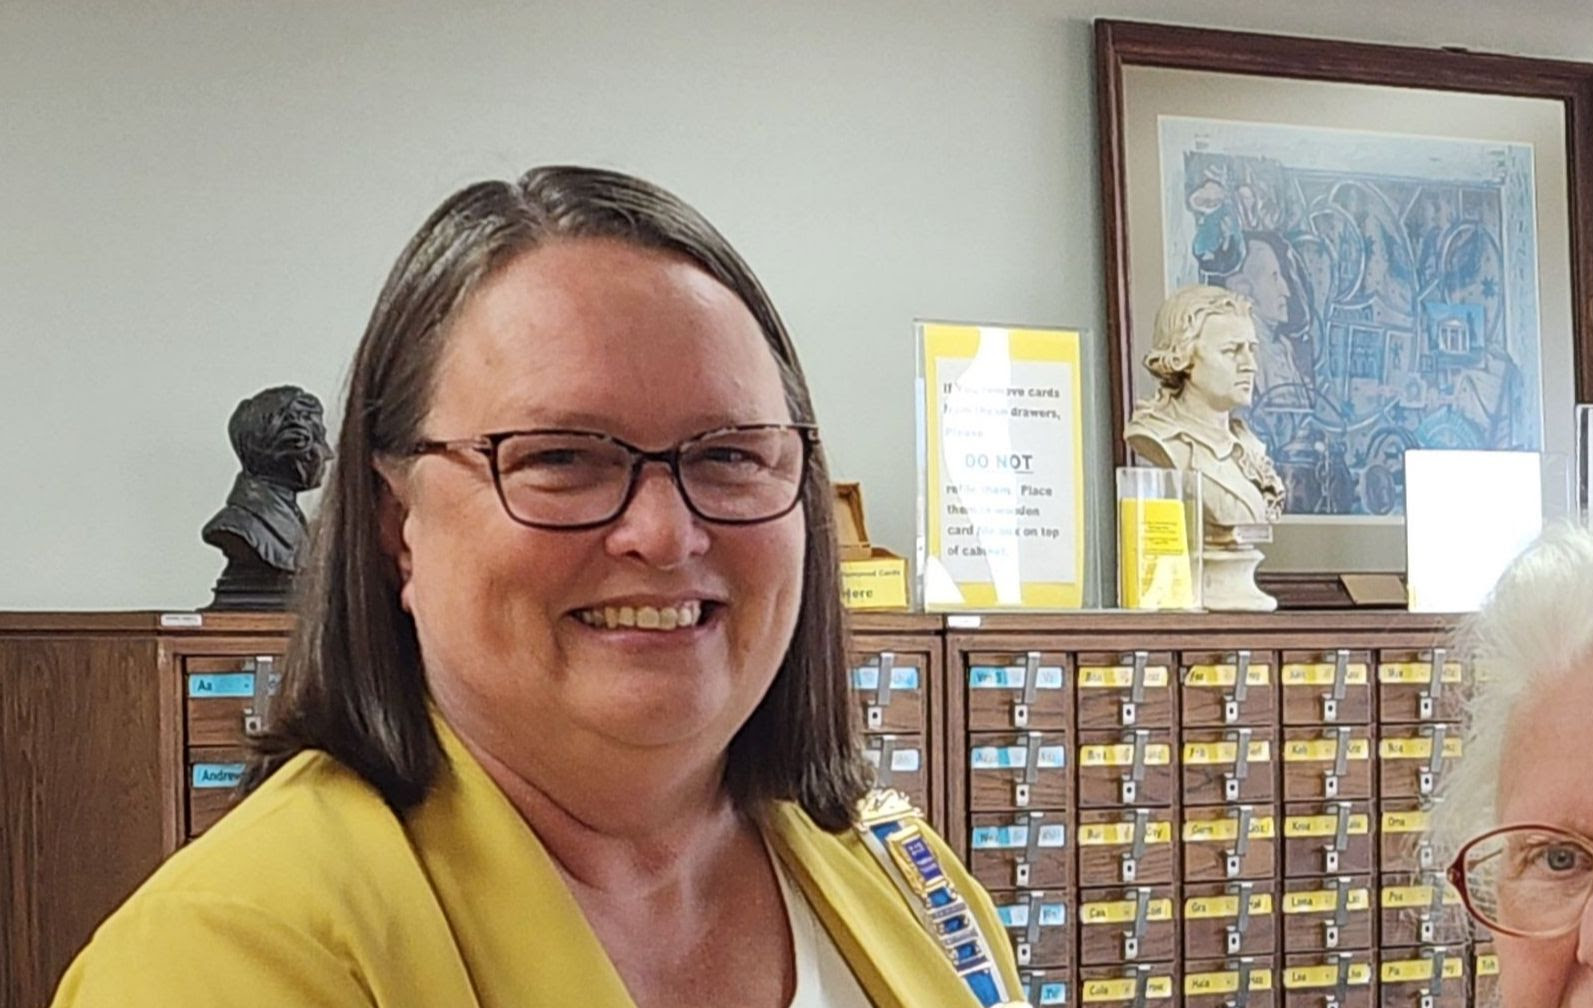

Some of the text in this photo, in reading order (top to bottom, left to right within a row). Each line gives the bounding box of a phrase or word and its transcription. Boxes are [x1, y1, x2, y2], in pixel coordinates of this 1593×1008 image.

[1028, 388, 1060, 399] cards
[1011, 406, 1061, 421] drawers,
[965, 454, 1033, 470] DO NOT
[1021, 484, 1053, 497] Place
[947, 524, 974, 536] card
[1041, 527, 1060, 540] top
[947, 544, 959, 556] of
